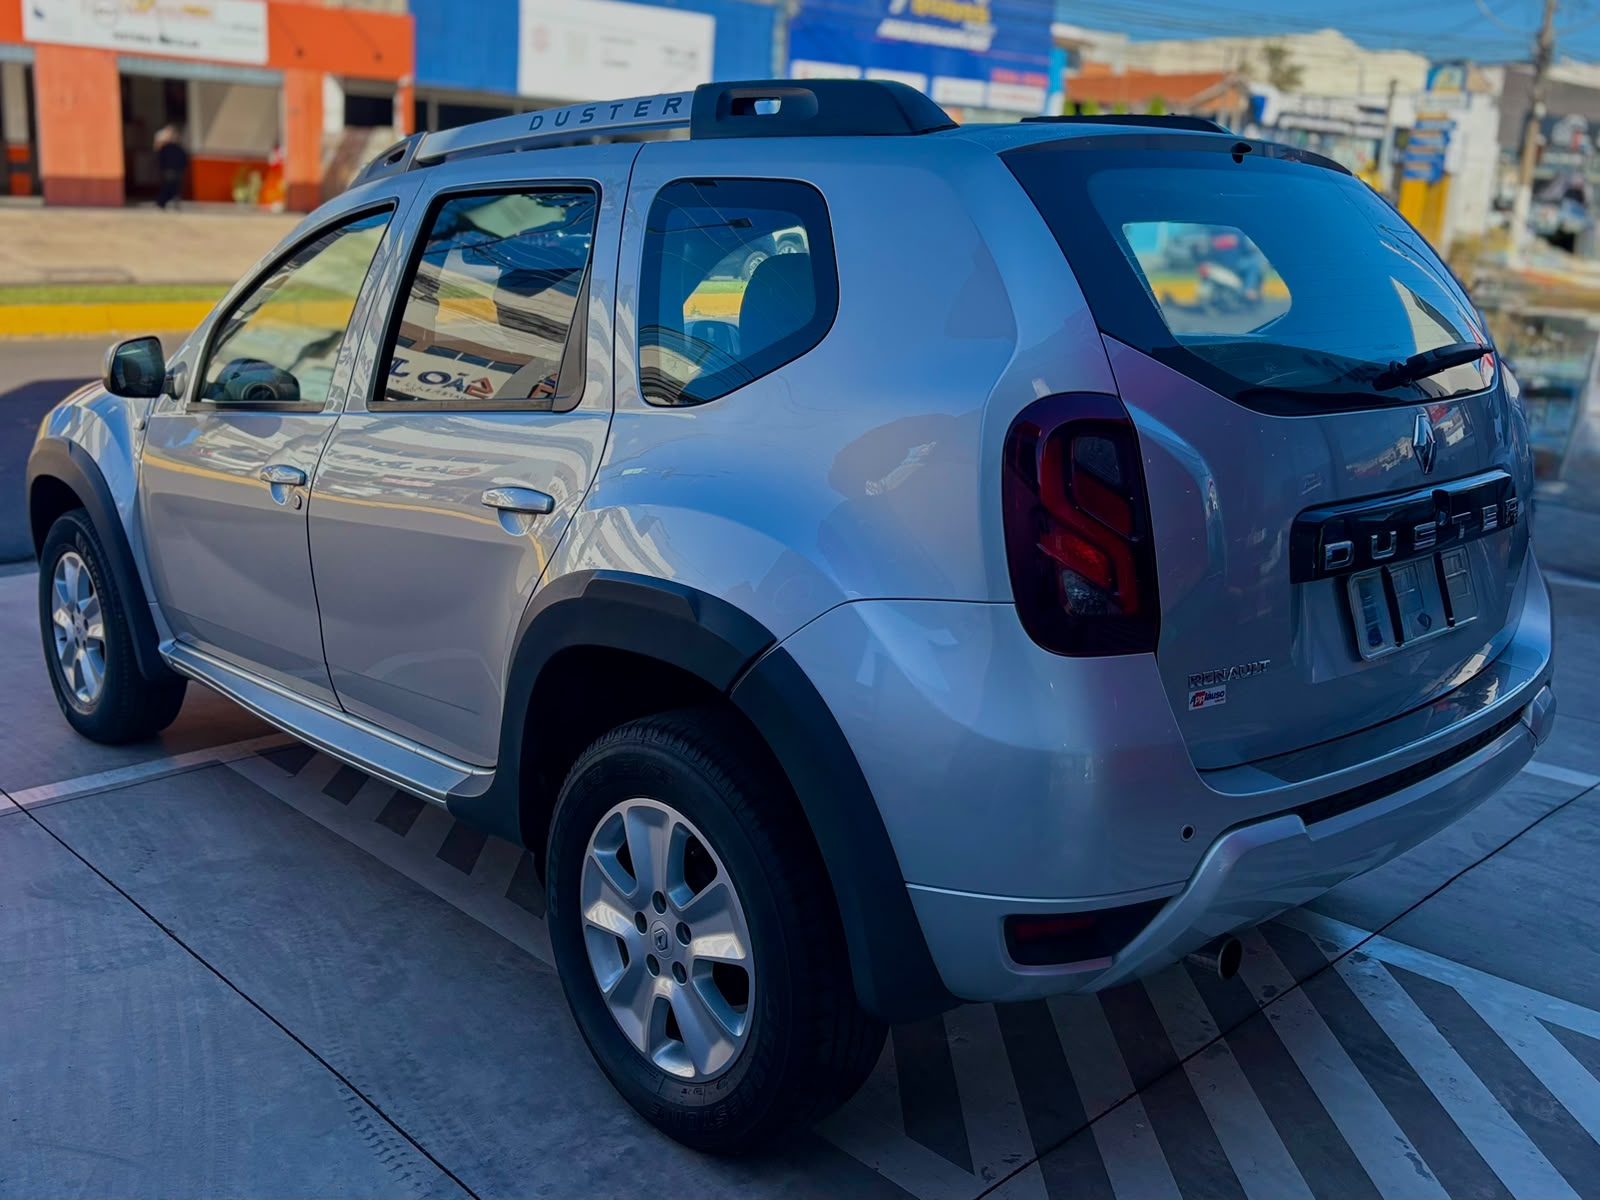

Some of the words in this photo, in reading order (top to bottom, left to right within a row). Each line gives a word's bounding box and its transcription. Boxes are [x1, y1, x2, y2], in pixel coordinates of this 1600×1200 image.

[529, 97, 682, 131] DUSTER
[1324, 497, 1518, 571] DUSTER
[1188, 659, 1271, 689] RENAULT
